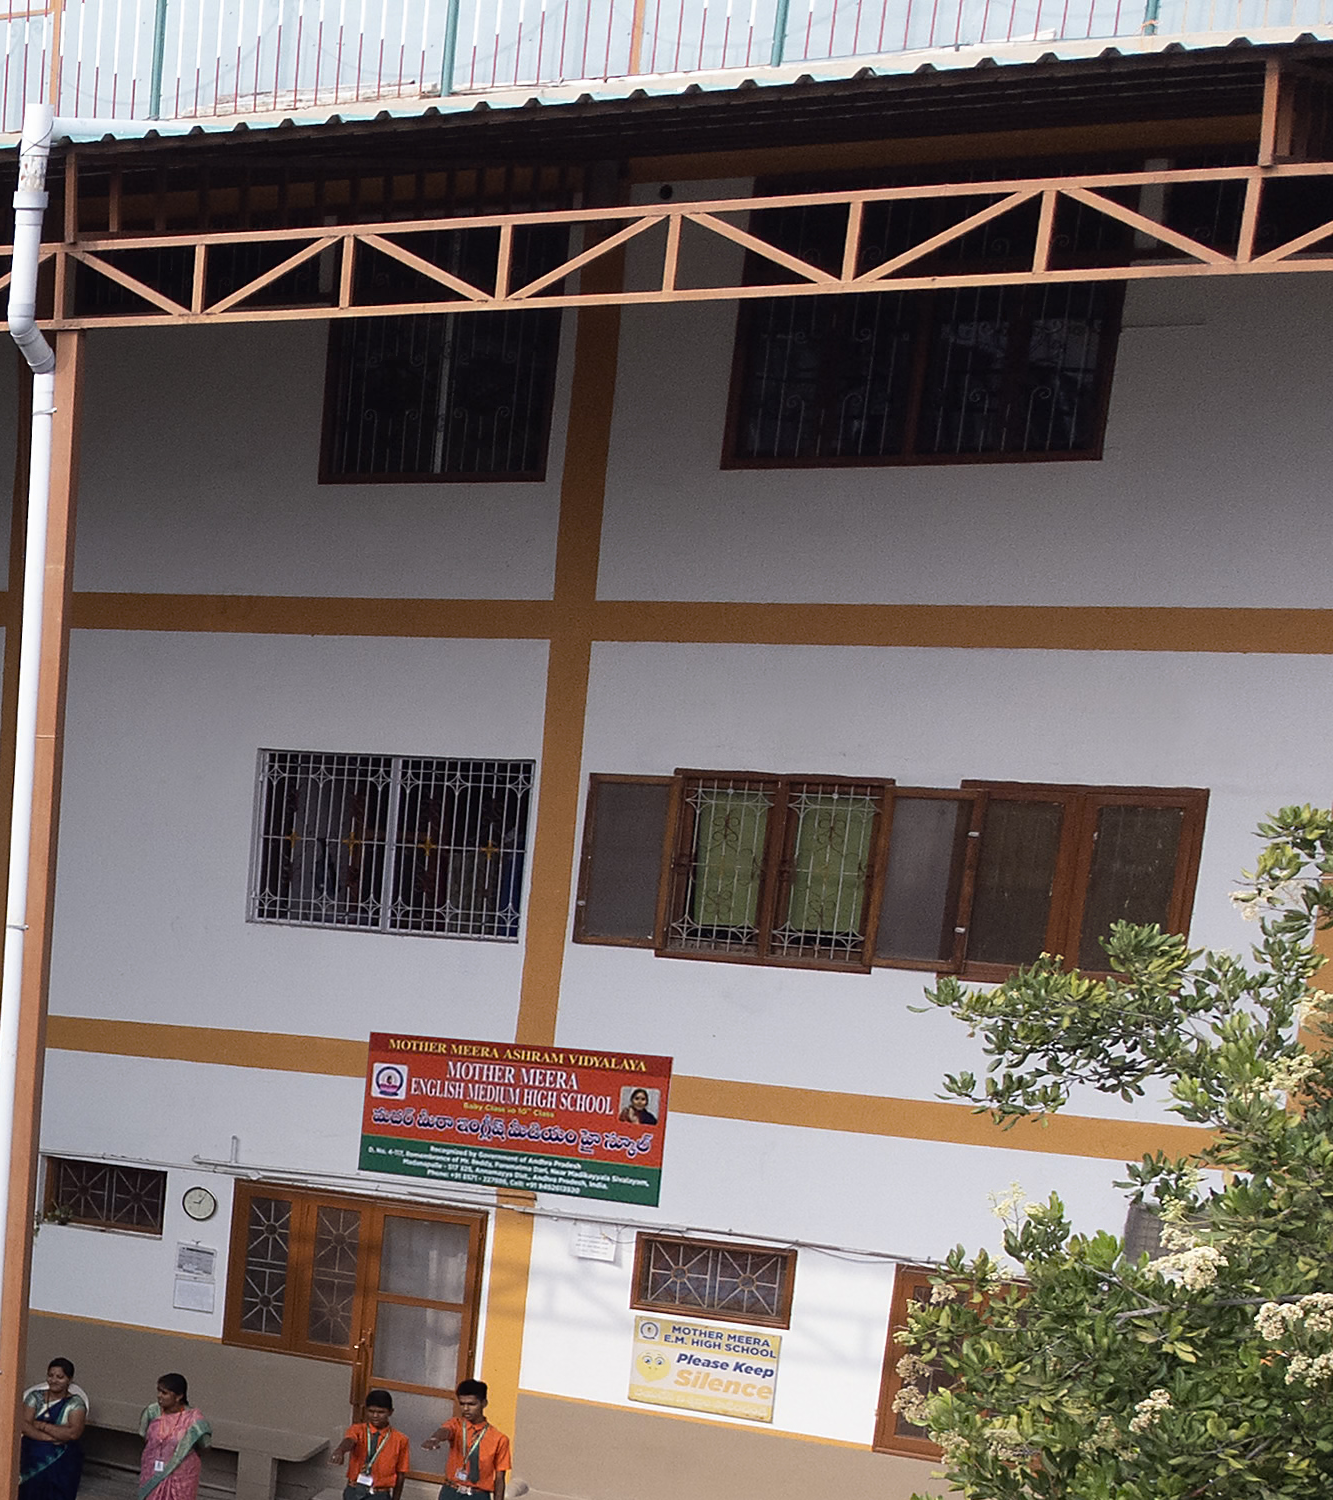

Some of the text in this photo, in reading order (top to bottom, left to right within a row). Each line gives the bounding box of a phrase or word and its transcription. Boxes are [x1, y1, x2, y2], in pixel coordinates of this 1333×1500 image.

[388, 1039, 646, 1072] MOTHER MEERA ASHRAM VIDYALAYA
[446, 1061, 579, 1090] MOTHER MEERA
[411, 1077, 614, 1115] ENGLISH MEDIUM HIGH SCHOOL
[663, 1334, 777, 1359] E.M. HIGH SCHOOL
[671, 1325, 771, 1348] MOTHER MEERA
[676, 1352, 775, 1379] Please Keep
[673, 1368, 773, 1401] Silence
